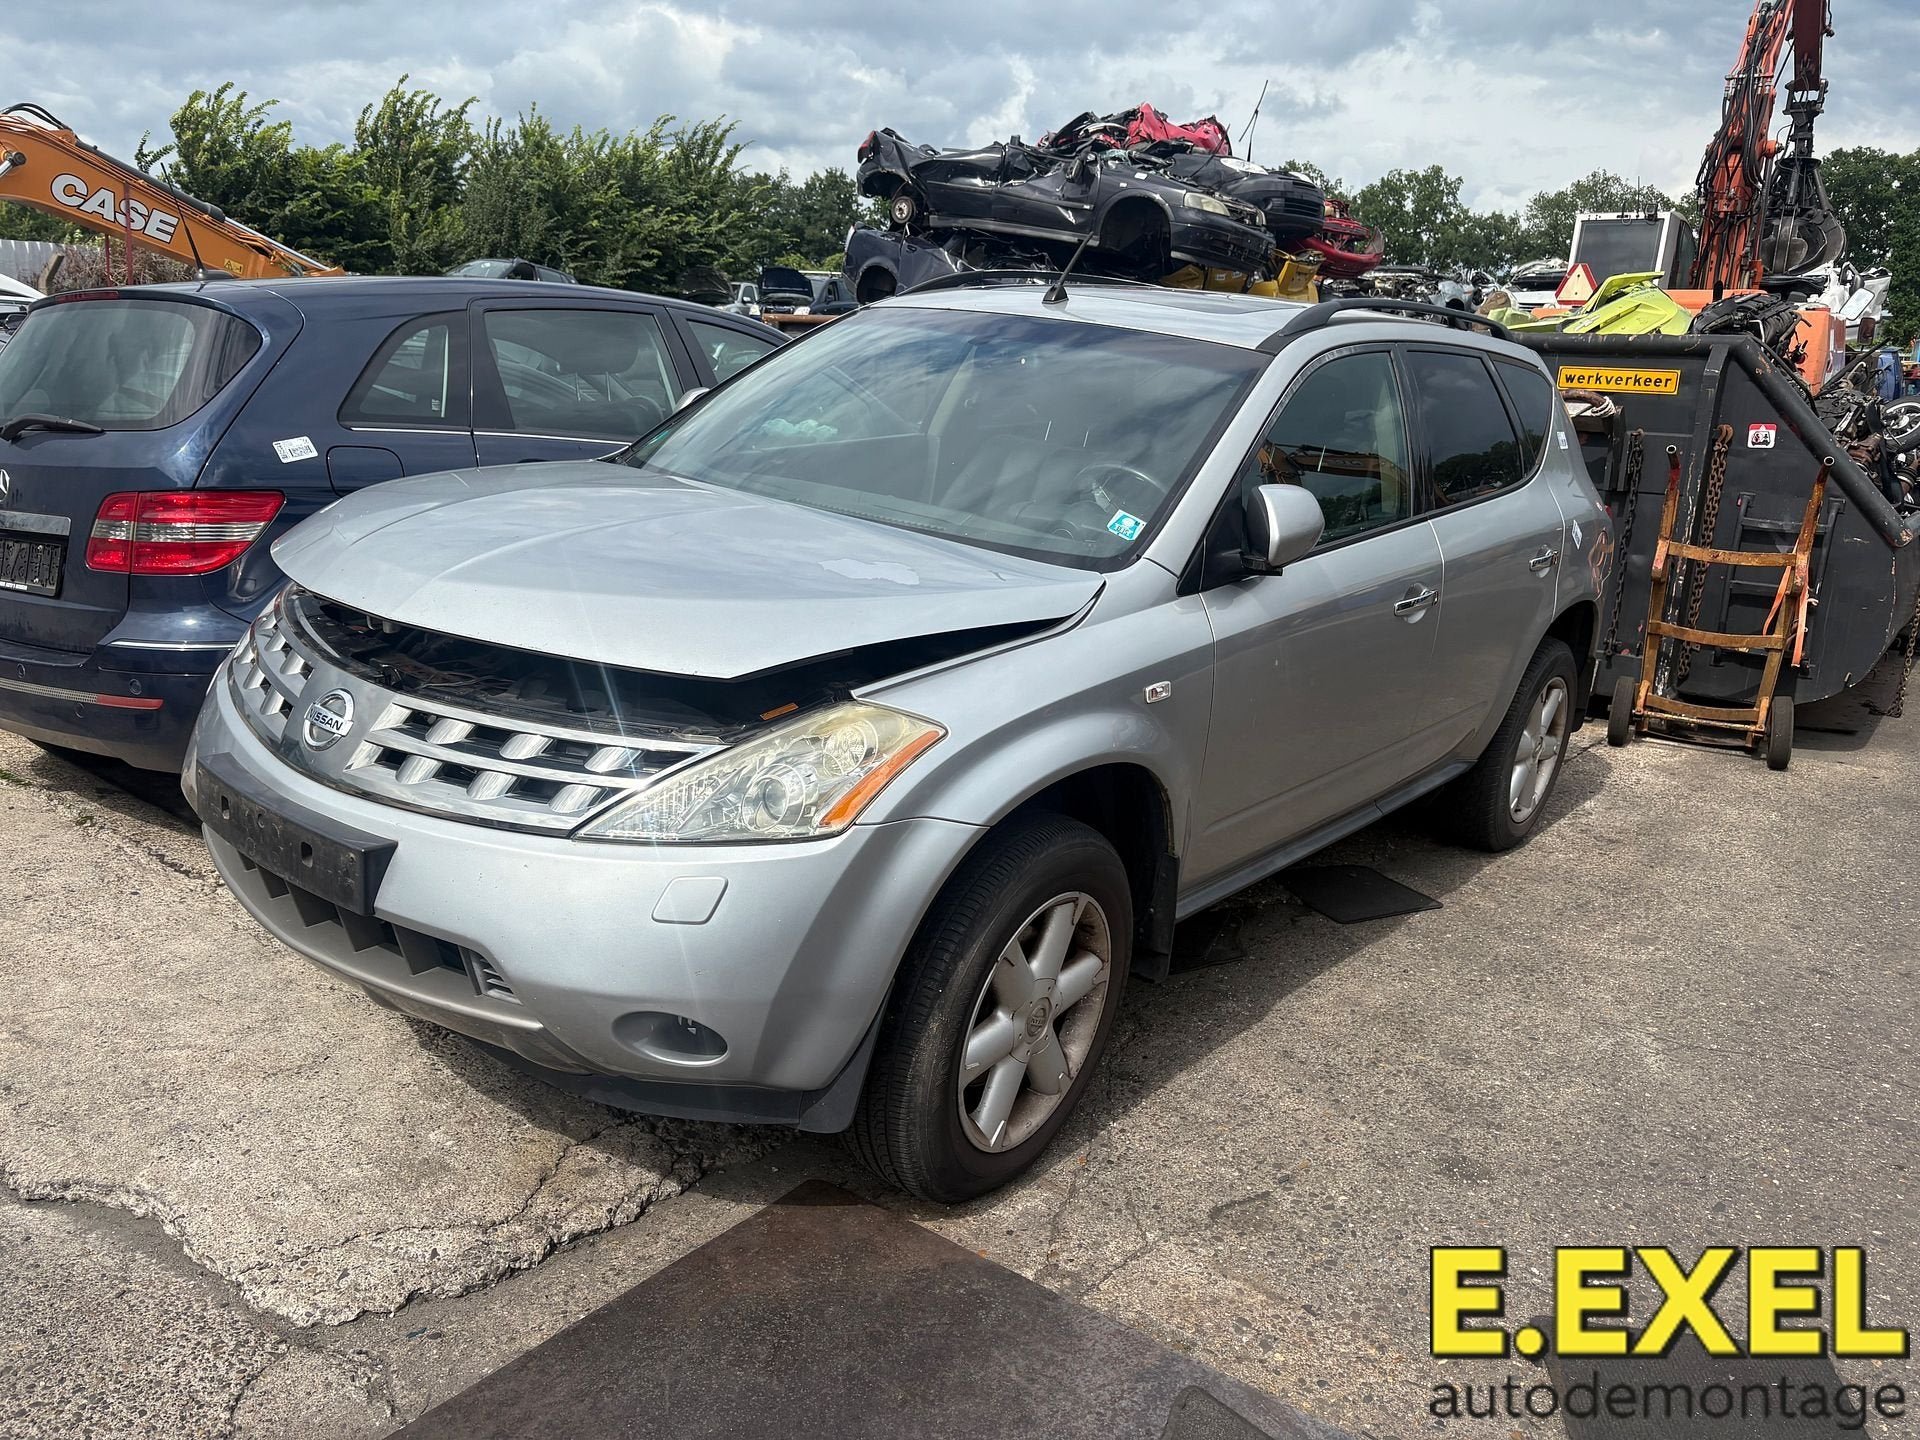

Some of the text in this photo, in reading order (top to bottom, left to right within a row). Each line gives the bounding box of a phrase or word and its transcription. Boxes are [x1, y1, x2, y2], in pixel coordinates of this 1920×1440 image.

[50, 173, 180, 244] CASE
[1565, 373, 1672, 387] werkverkeer
[309, 708, 343, 731] NISSAN
